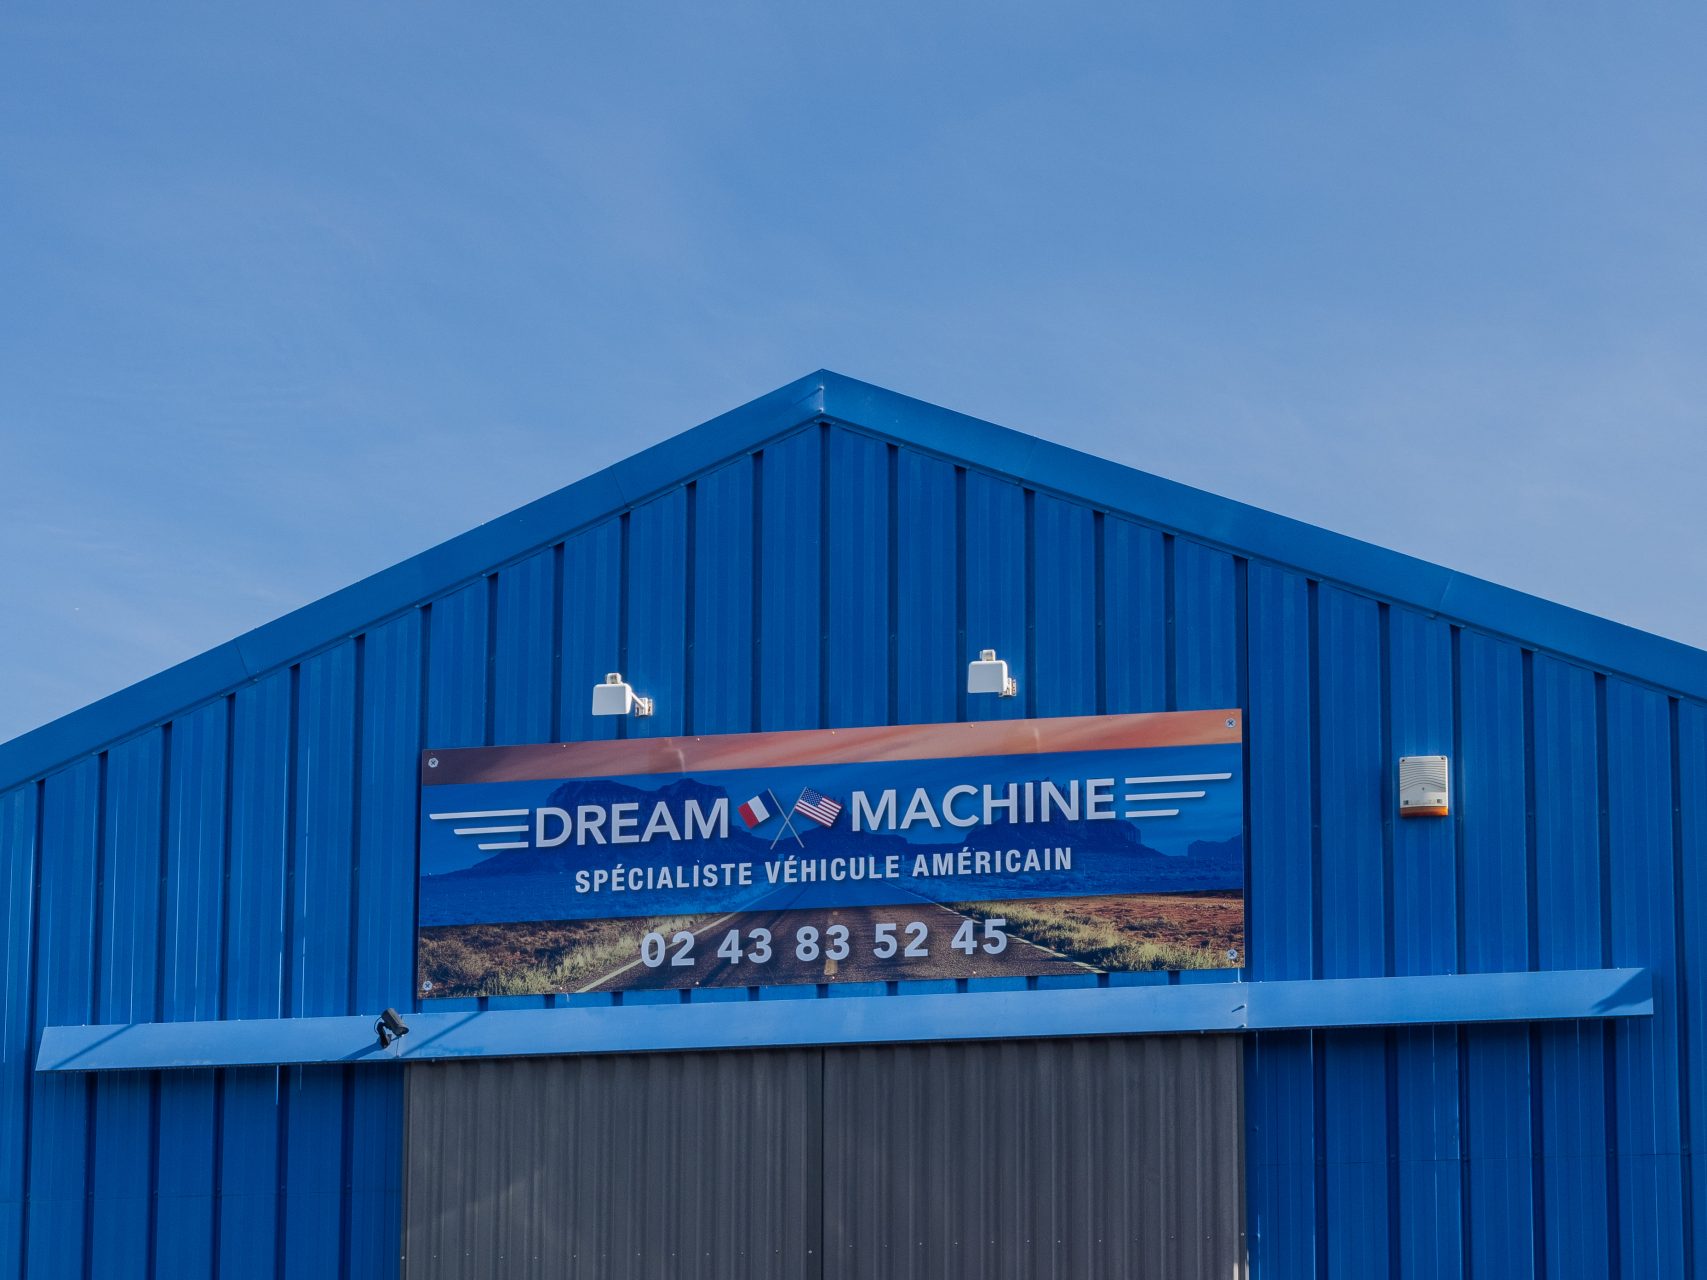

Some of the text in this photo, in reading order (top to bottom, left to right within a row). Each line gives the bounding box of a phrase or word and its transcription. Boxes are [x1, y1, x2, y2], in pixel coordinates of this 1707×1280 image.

[535, 778, 1117, 848] DREAM MACHINE
[575, 846, 1072, 893] SPÉCIALISTE VÉHICULE AMÉRICAIN
[640, 918, 1008, 968] 02 43 83 52 45
